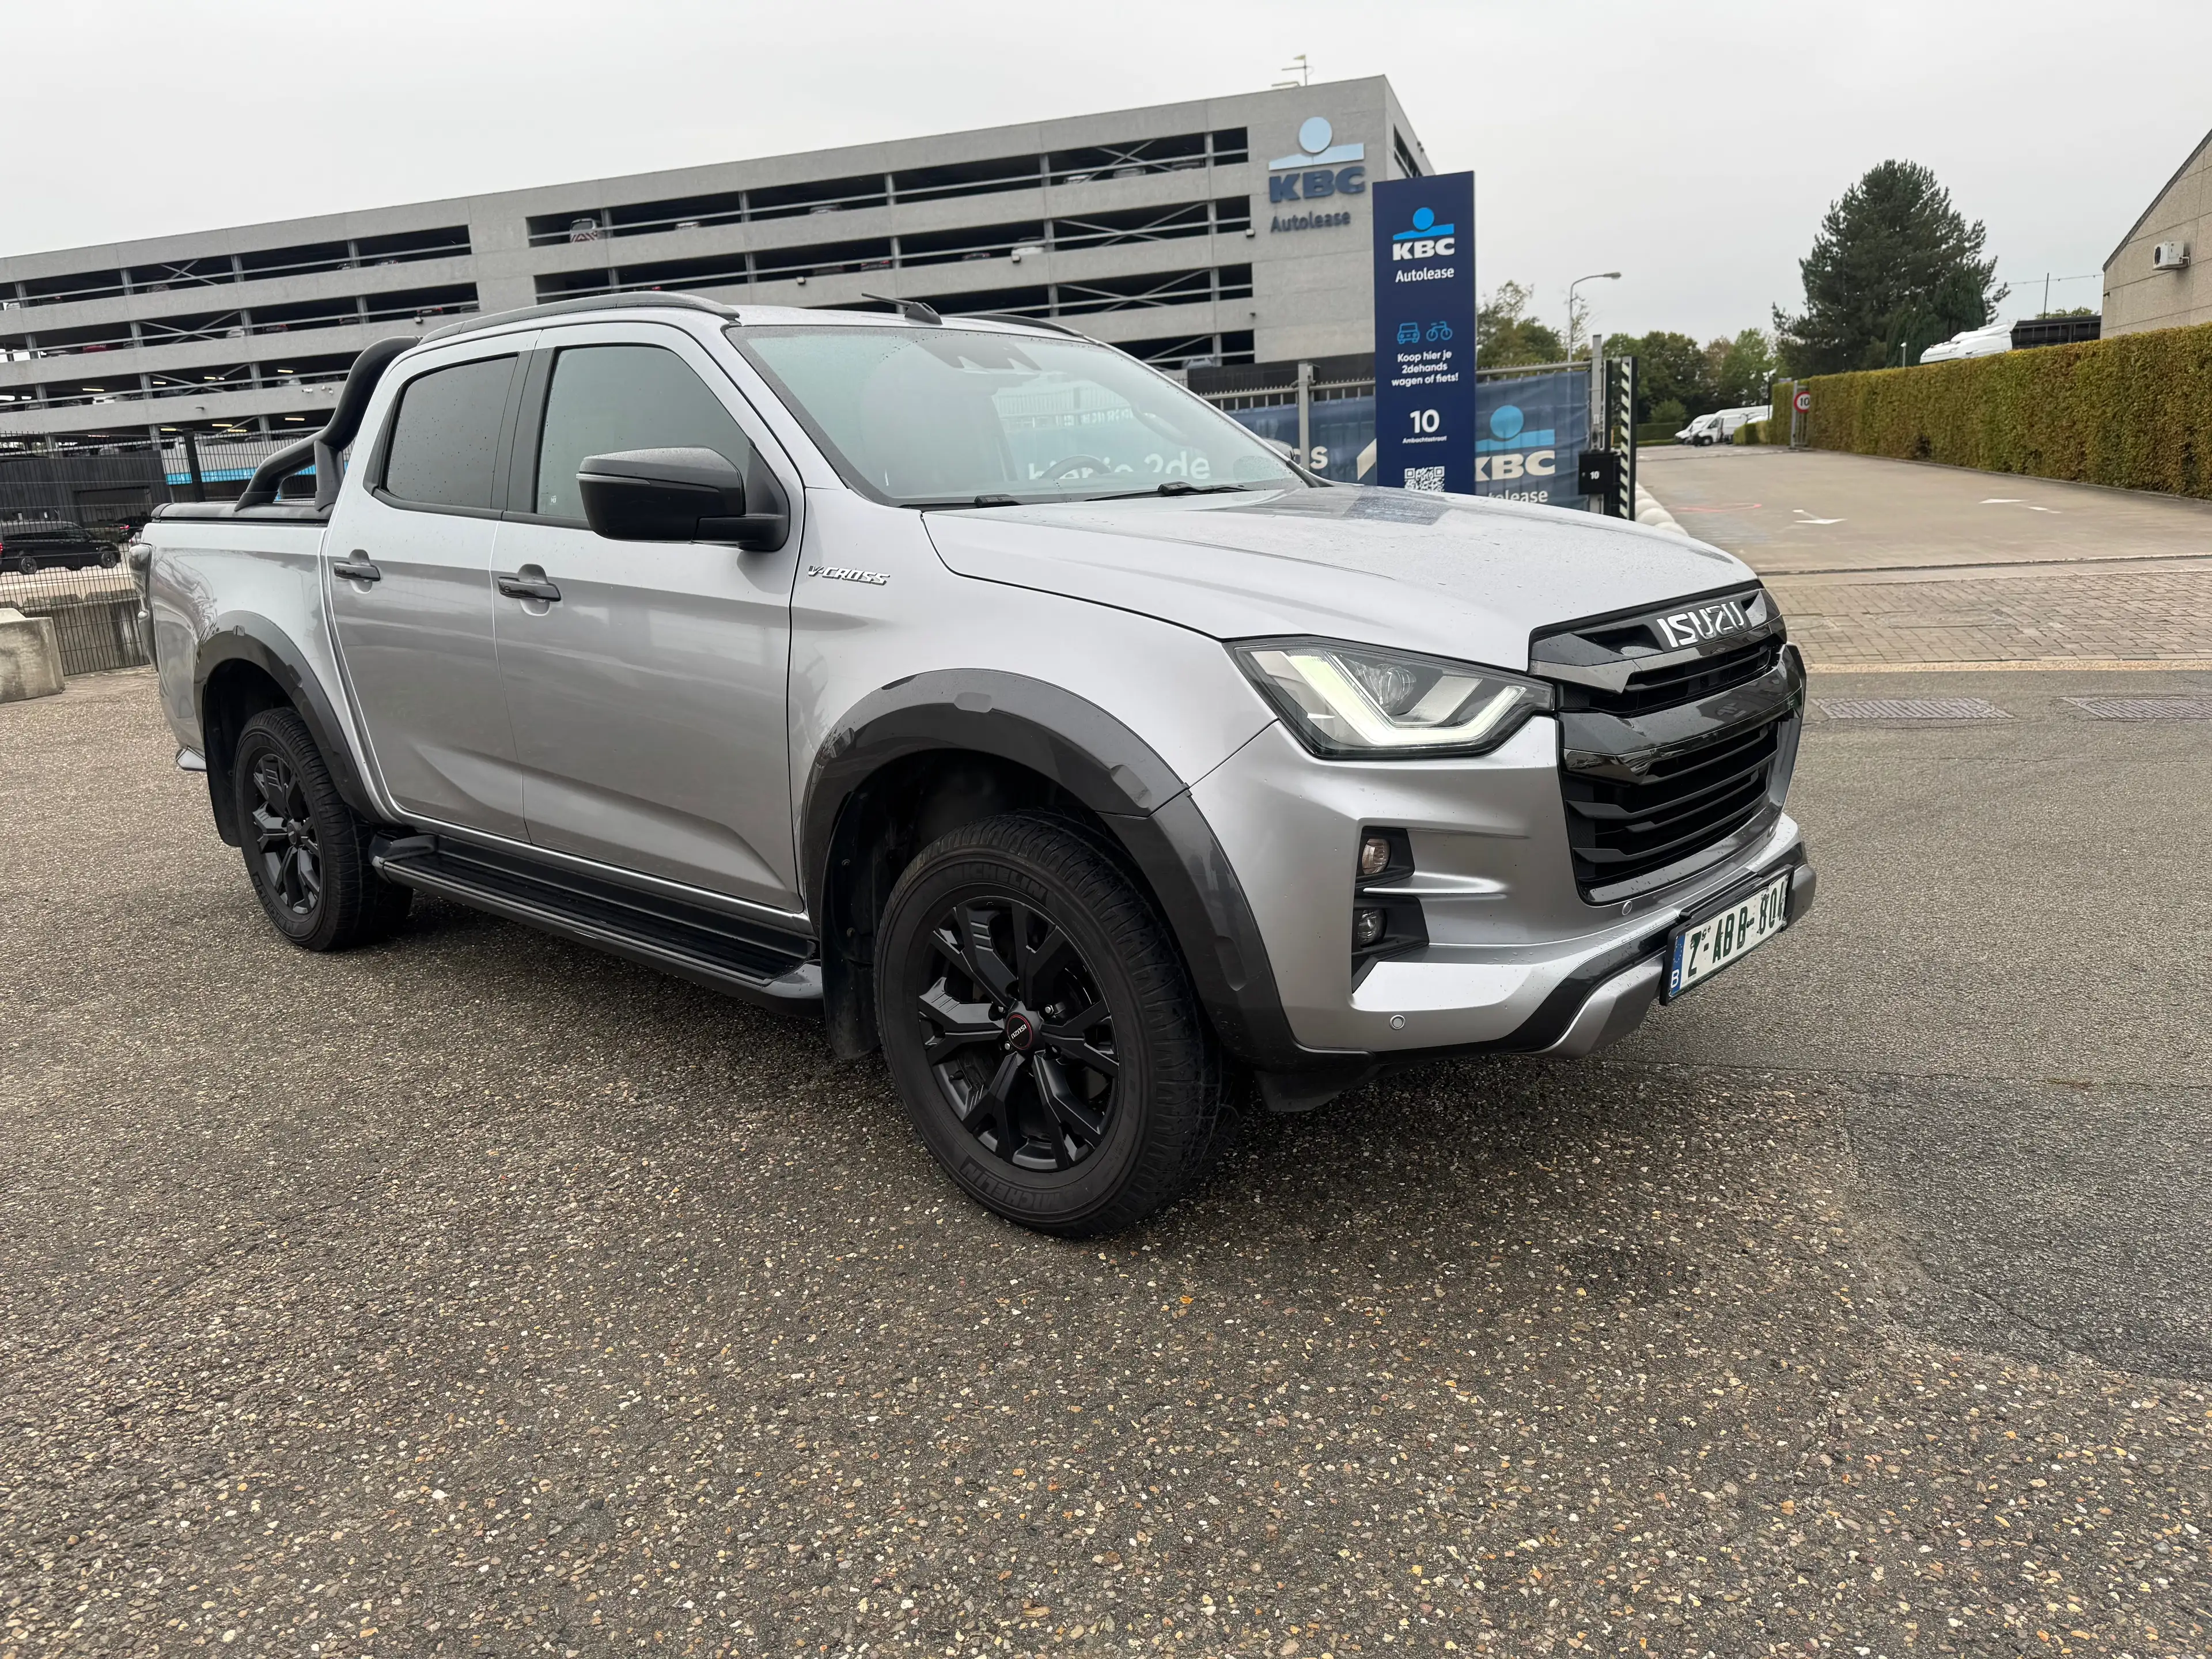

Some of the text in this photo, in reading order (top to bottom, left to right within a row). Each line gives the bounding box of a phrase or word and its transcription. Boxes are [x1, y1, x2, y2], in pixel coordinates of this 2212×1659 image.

[1269, 166, 1366, 203] KBC
[1271, 210, 1351, 233] Autolease
[1392, 237, 1455, 260] KBC
[1395, 267, 1455, 283] Autolease
[1397, 349, 1452, 363] Koop hier je
[1402, 362, 1448, 374] 2dehands
[1391, 372, 1459, 387] wagen of fiets!
[1800, 397, 1810, 407] 10
[1410, 408, 1440, 433] 10
[1590, 471, 1600, 479] 10
[808, 565, 891, 586] V-CROSS
[1657, 601, 1747, 648] ISUZU
[1671, 969, 1680, 988] B
[1011, 1024, 1027, 1039] ISUZU
[959, 1162, 1060, 1210] MICHELIN
